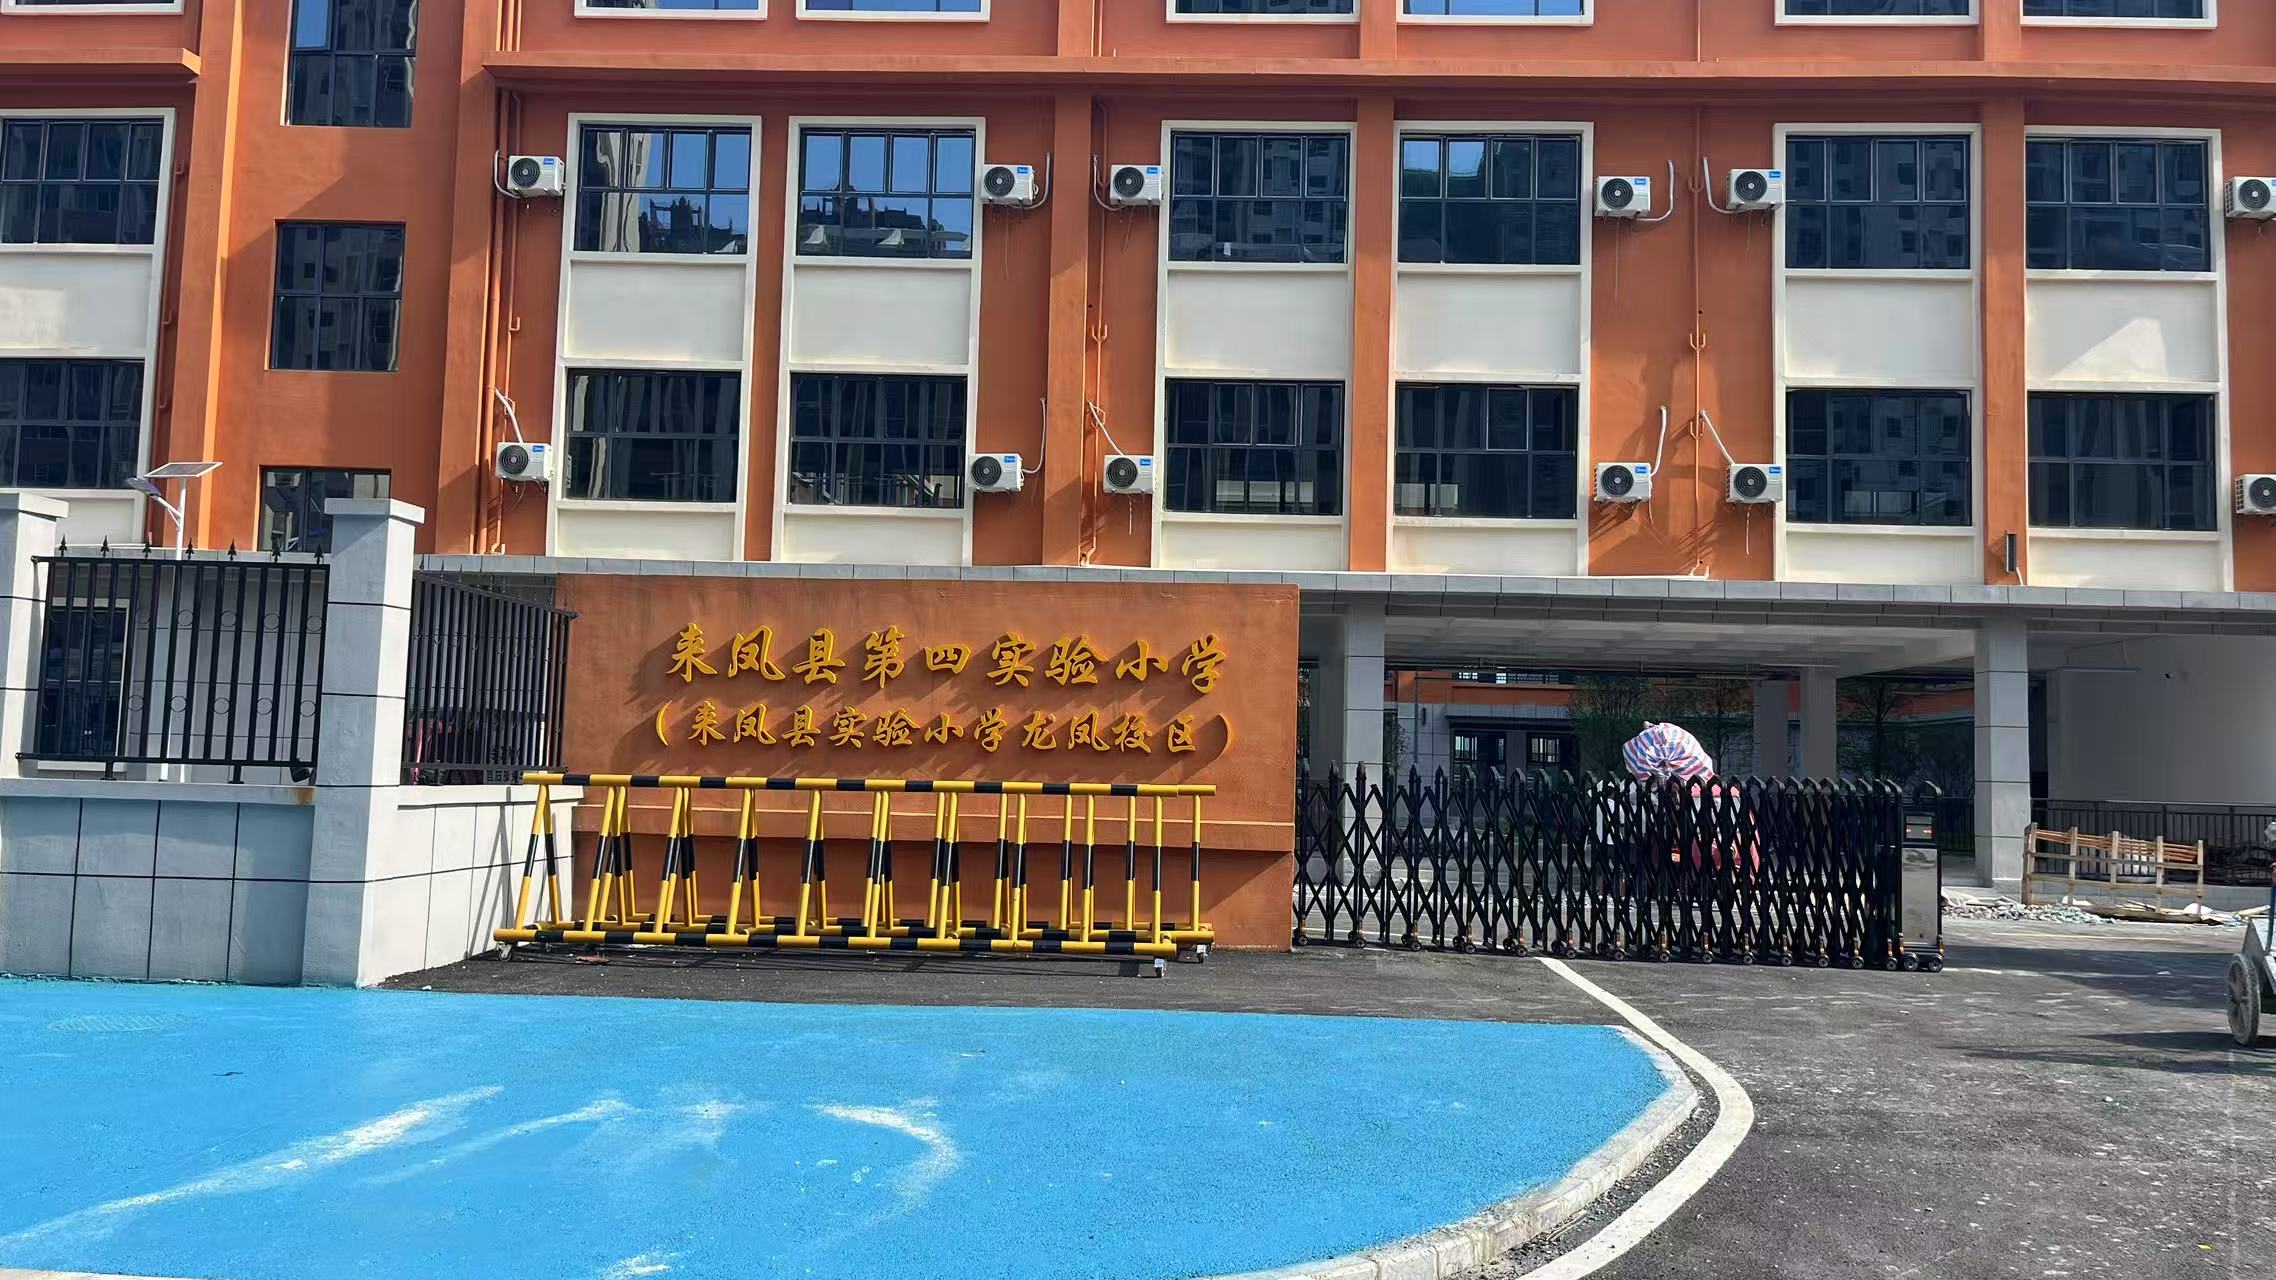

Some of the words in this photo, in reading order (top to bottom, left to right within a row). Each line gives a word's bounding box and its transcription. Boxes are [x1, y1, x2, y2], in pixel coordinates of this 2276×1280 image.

[665, 622, 1227, 694] 来凤县第四实验小学
